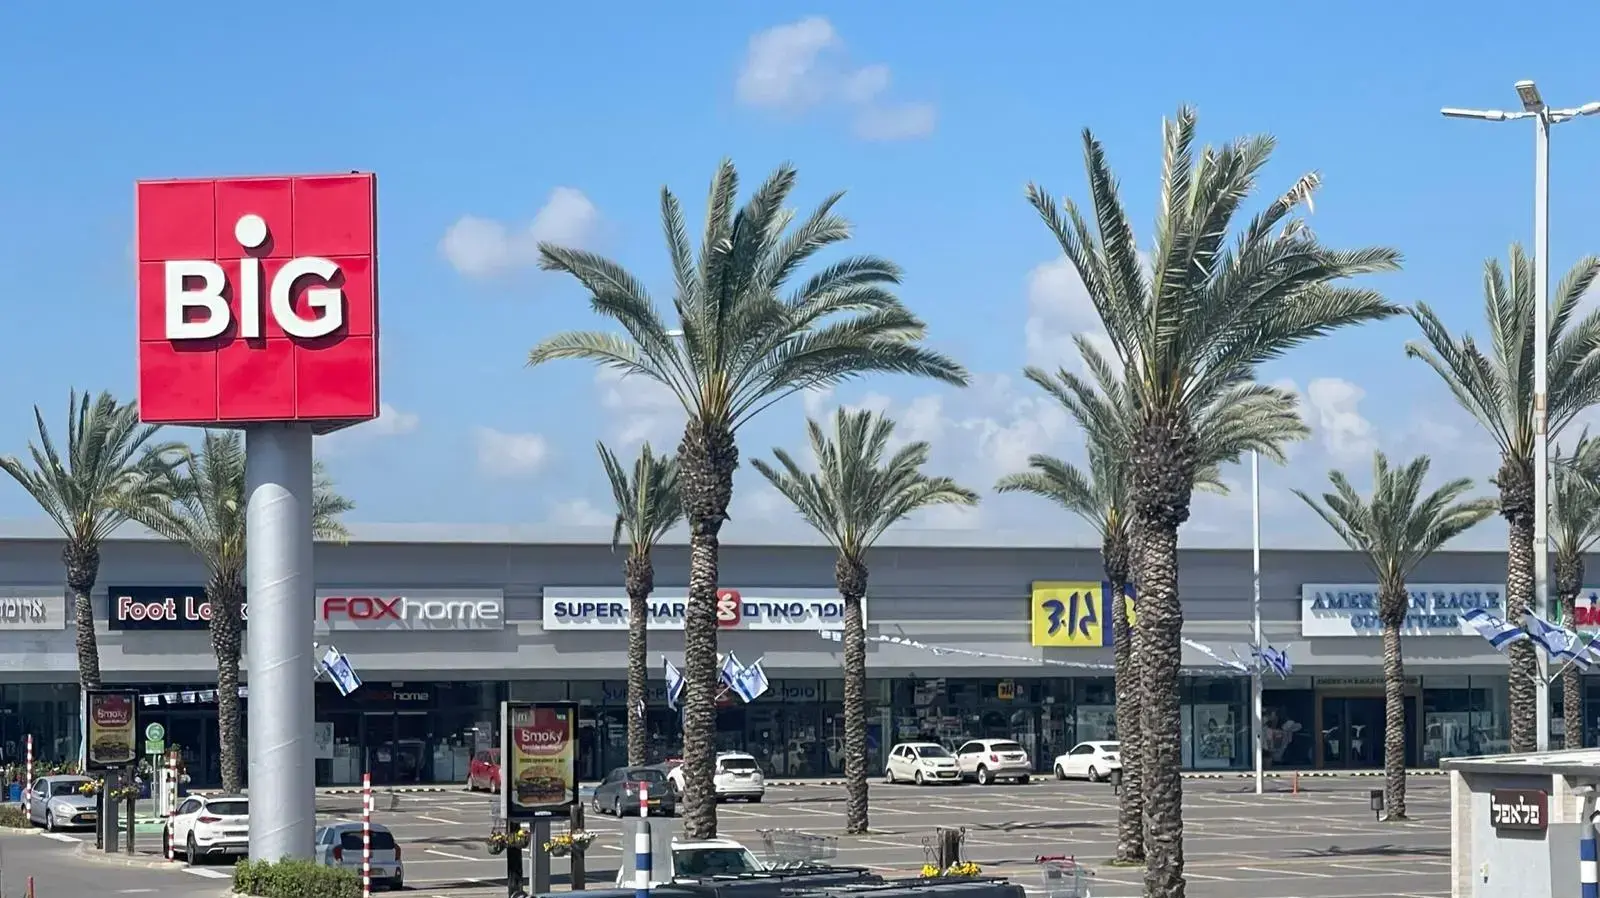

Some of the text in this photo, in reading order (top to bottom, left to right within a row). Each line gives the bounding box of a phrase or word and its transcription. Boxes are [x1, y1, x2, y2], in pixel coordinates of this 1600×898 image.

[0, 598, 43, 617] ארומ
[118, 596, 176, 620] Foot
[1433, 592, 1500, 609] EAGLE
[521, 730, 563, 744] Smoky
[1491, 795, 1540, 824] פלאפל
